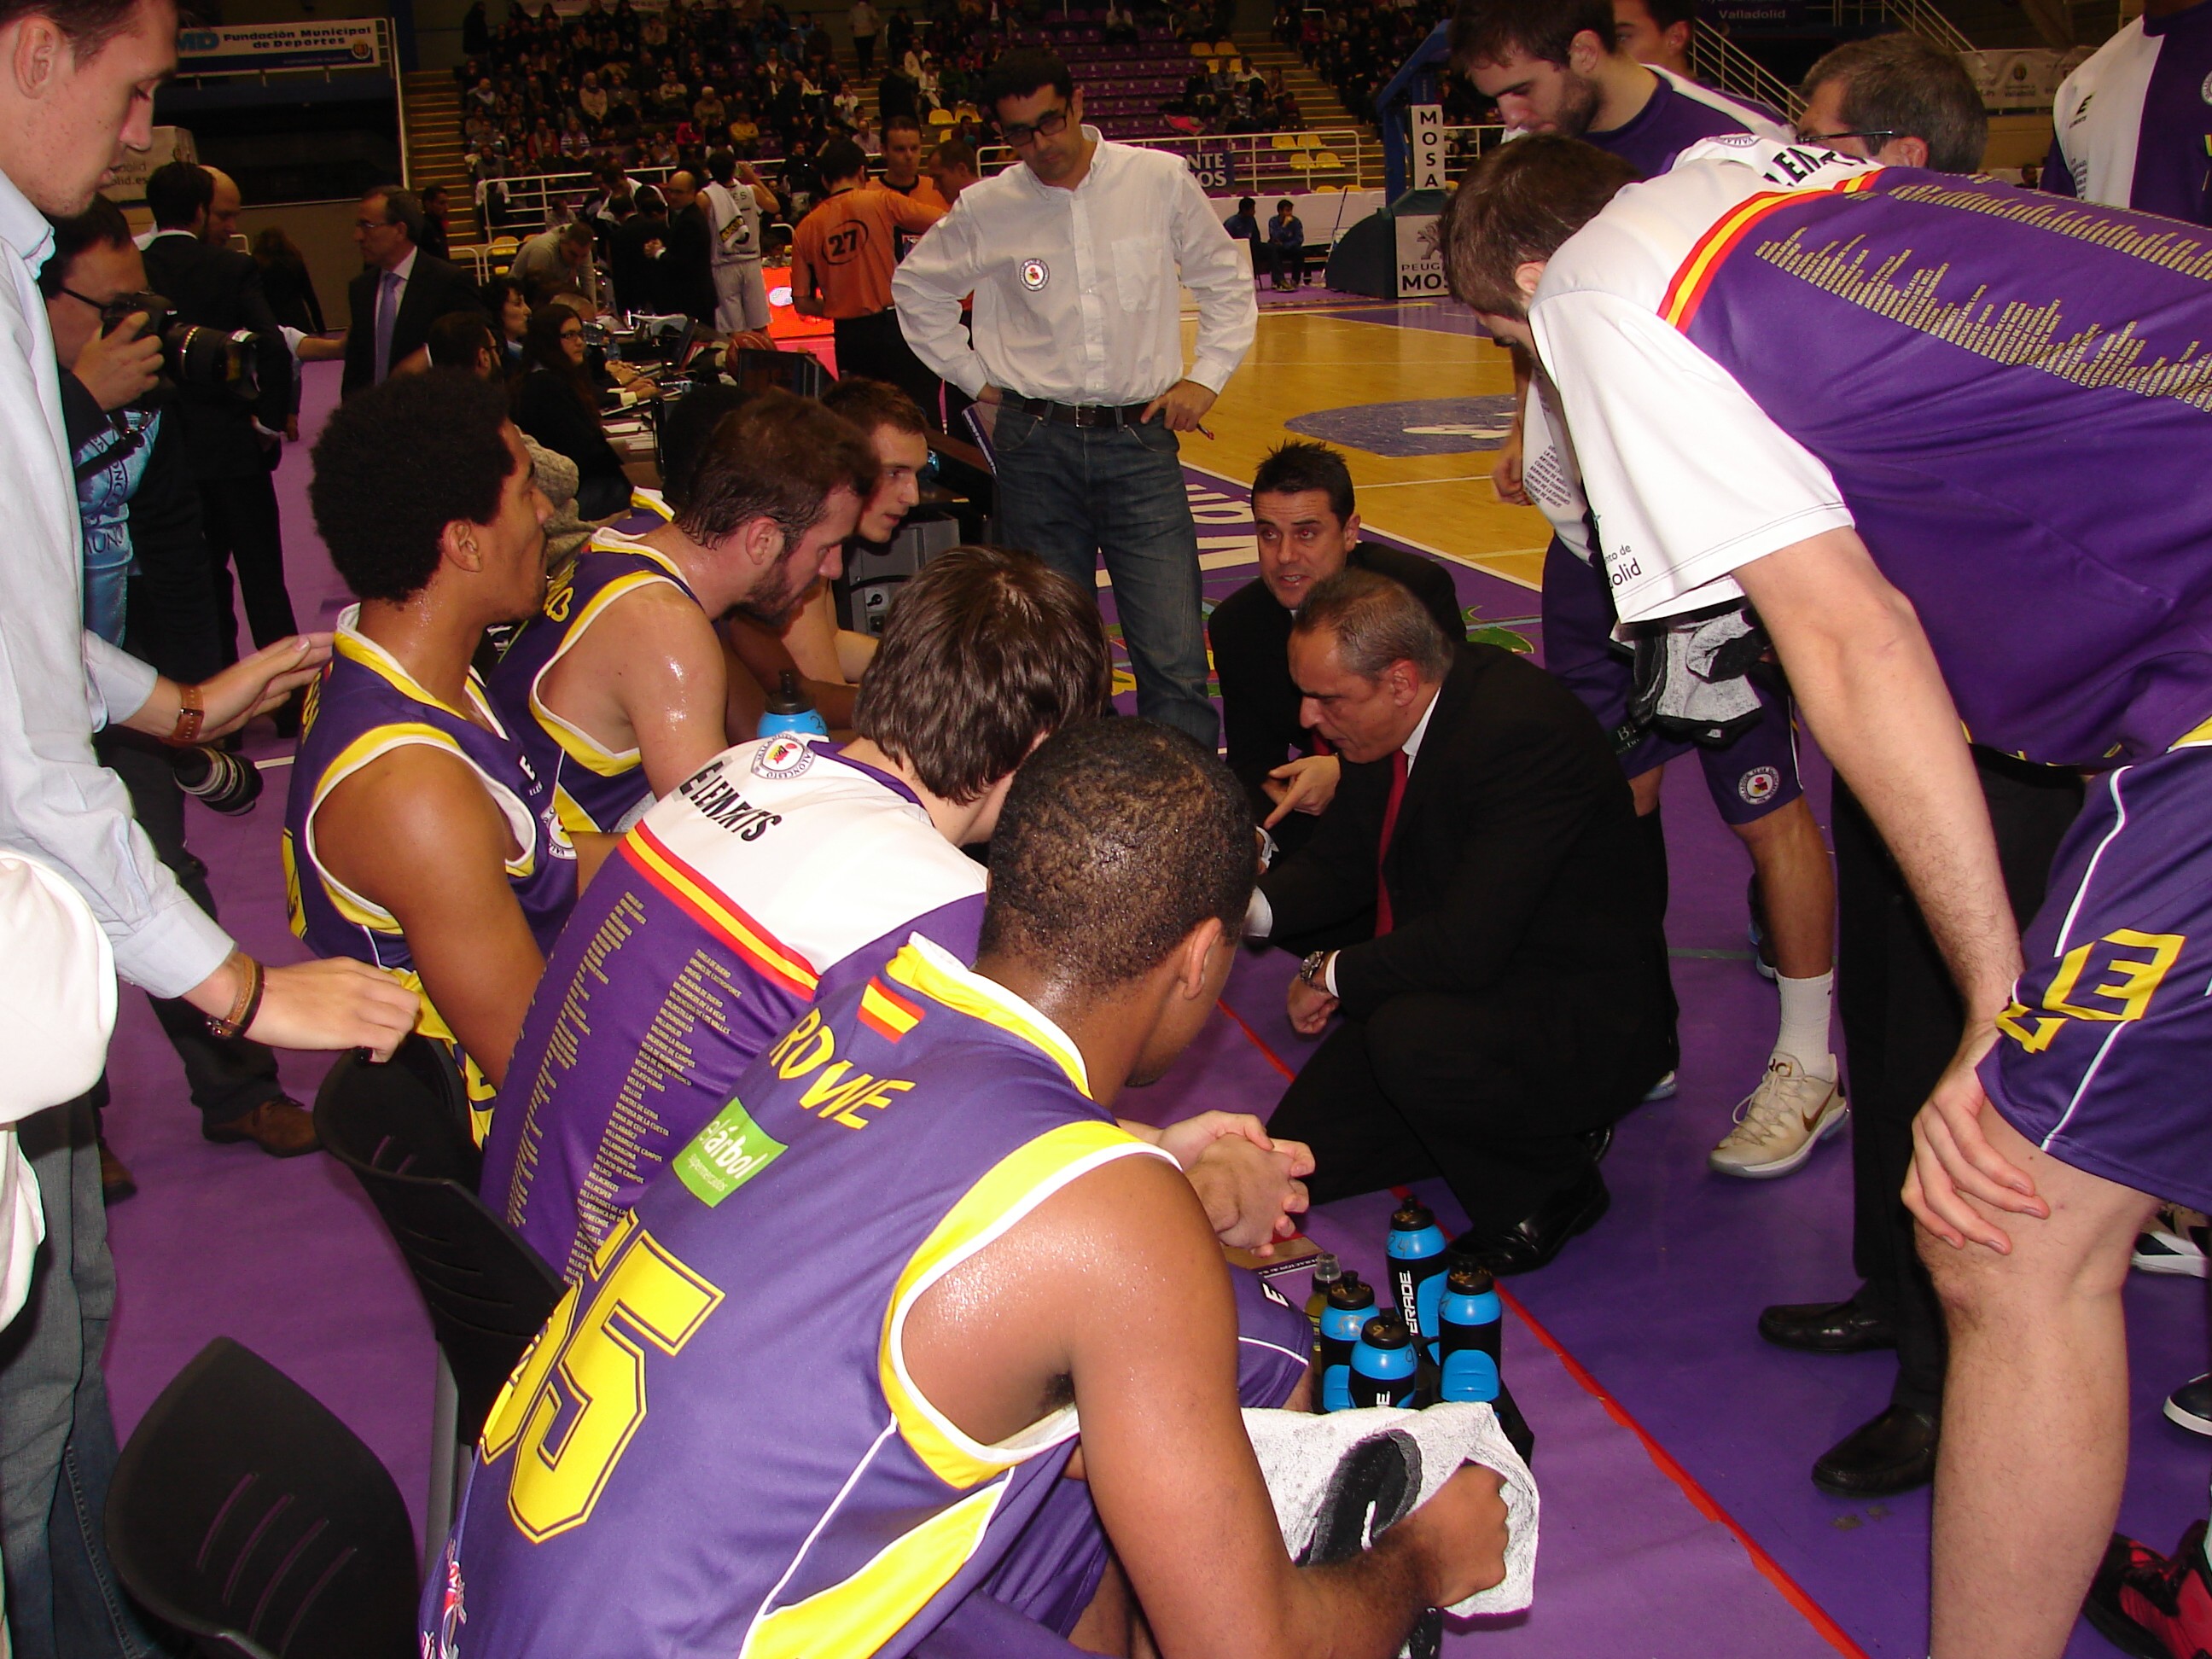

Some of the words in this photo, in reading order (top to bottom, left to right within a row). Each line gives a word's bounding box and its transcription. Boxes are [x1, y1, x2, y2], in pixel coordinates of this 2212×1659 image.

[1719, 9, 1786, 20] Valladolid
[300, 26, 371, 38] Municipal
[274, 37, 346, 49] Deportes
[1420, 111, 1439, 187] MOSA
[828, 230, 858, 256] 27
[1401, 262, 1441, 272] PEUG
[768, 1007, 917, 1131] ROWE
